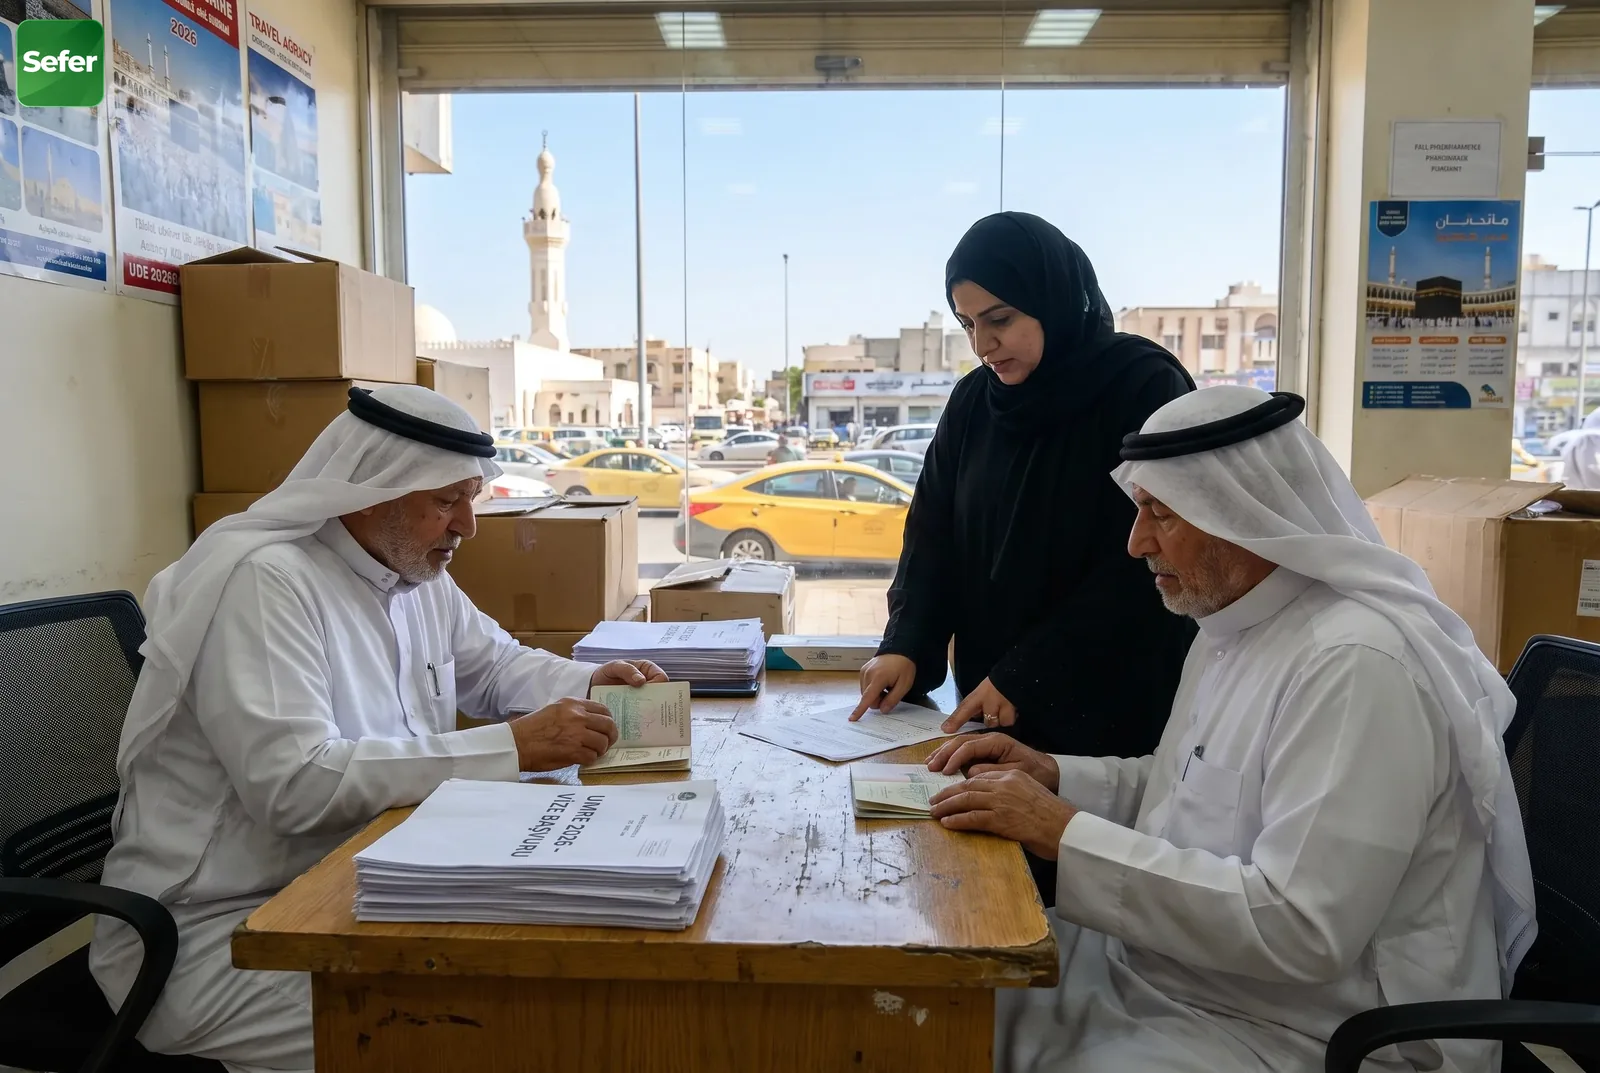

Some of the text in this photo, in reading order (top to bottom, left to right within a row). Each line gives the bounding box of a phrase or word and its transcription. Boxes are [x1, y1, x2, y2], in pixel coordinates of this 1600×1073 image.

[170, 17, 197, 46] 2026
[248, 11, 282, 45] TRAVEL
[129, 262, 149, 279] UDE
[572, 795, 605, 822] UMRE
[511, 793, 575, 857] VİZE BAŞVURU
